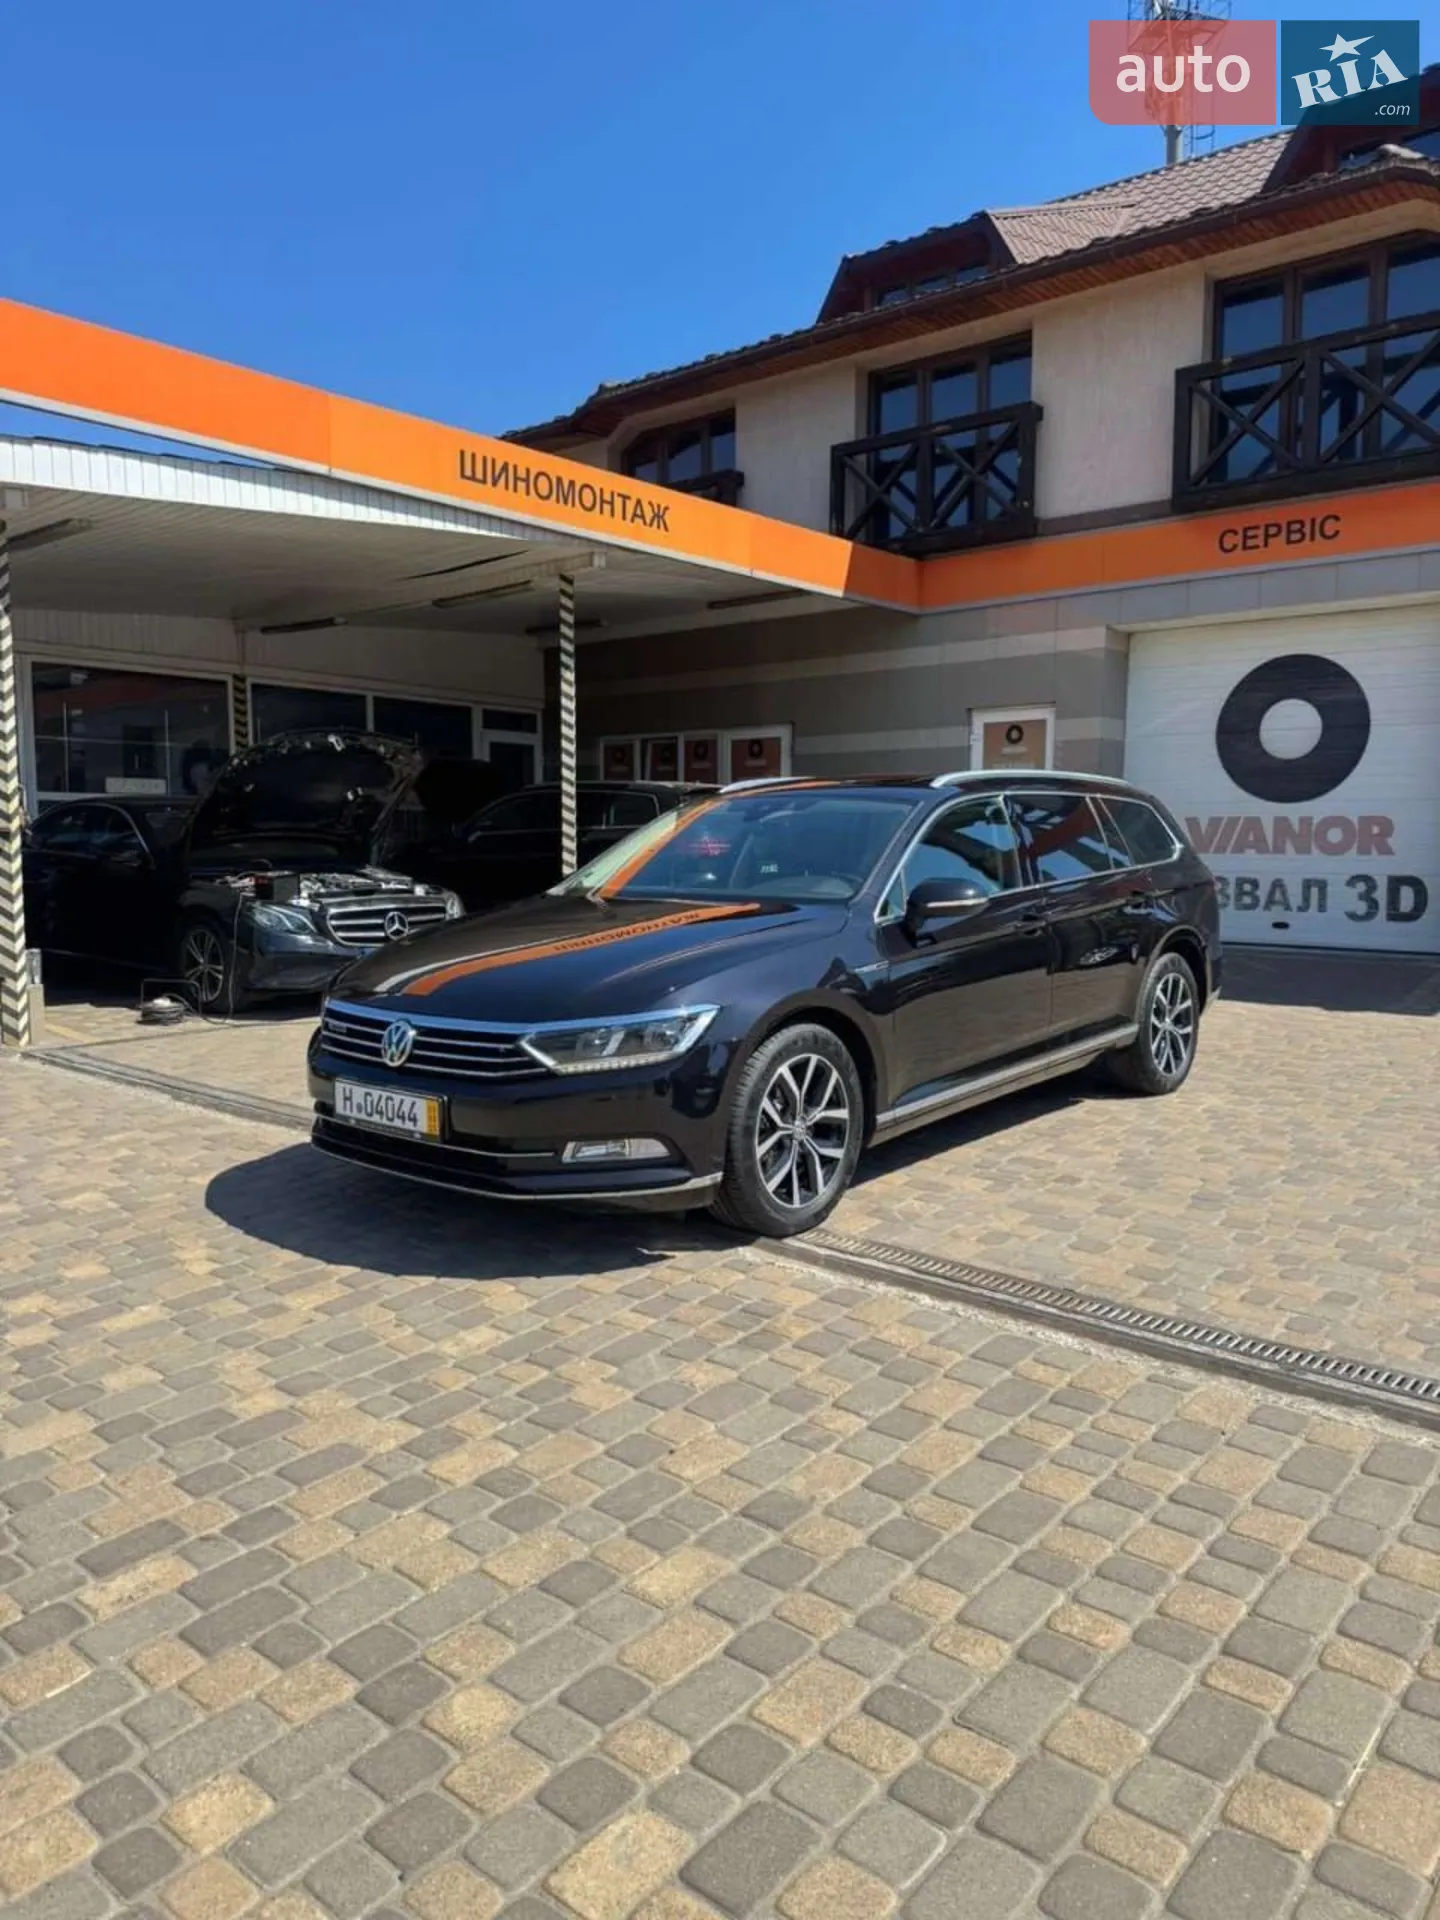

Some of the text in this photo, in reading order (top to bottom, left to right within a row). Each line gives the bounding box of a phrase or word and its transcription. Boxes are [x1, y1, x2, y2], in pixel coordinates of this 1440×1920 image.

[458, 449, 670, 532] ШИНОМОНТАЖ
[1218, 514, 1342, 553] СЕРВІС
[1184, 815, 1396, 856] VIANOR
[1344, 874, 1429, 923] 3D
